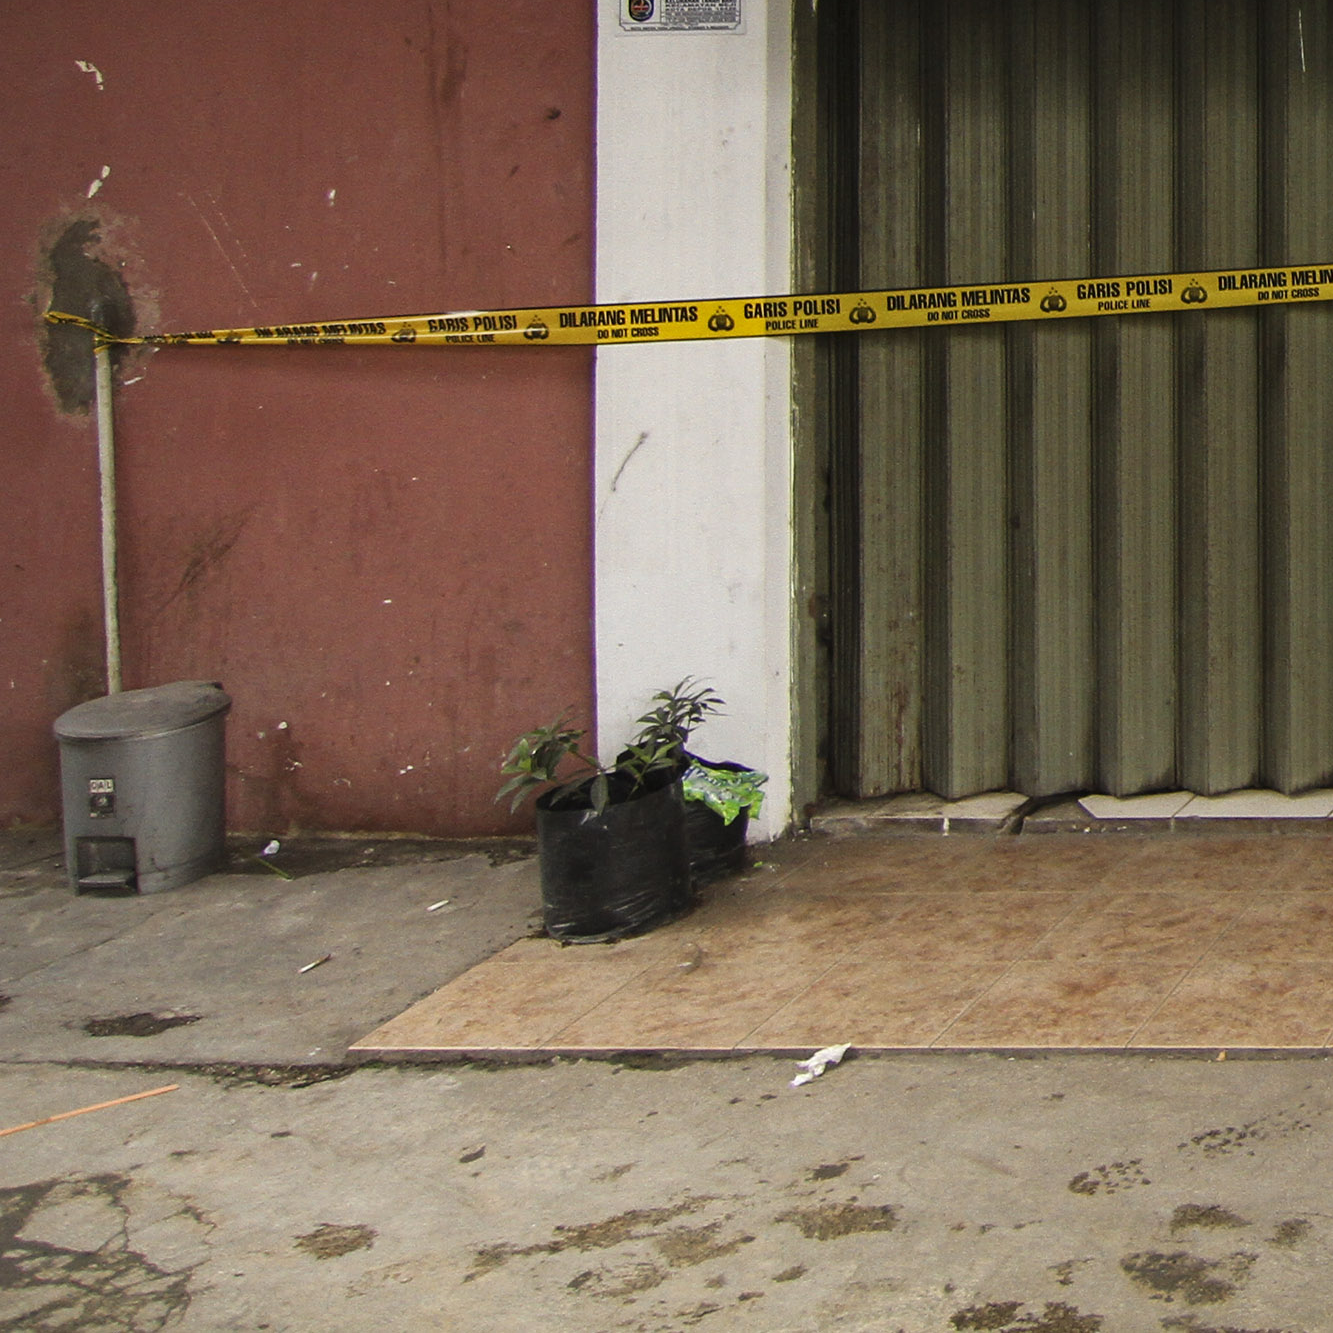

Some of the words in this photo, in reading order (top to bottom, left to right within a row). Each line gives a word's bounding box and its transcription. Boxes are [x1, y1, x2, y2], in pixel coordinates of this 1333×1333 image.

[1076, 283, 1121, 300] GARIS
[1126, 279, 1173, 296] POLISI
[1217, 272, 1287, 291] DILARANG
[743, 302, 788, 319] GARIS
[793, 298, 841, 316] POLISI
[886, 291, 957, 311] DILARANG
[961, 287, 1031, 307] MELINTAS
[1097, 299, 1129, 311] POLICE
[1131, 298, 1151, 309] LINE
[427, 318, 471, 333] GARIS
[474, 314, 518, 331] POLISI
[559, 309, 626, 328] DILARANG
[630, 306, 698, 324] MELINTAS
[765, 320, 796, 331] POLICE
[799, 318, 819, 329] LINE
